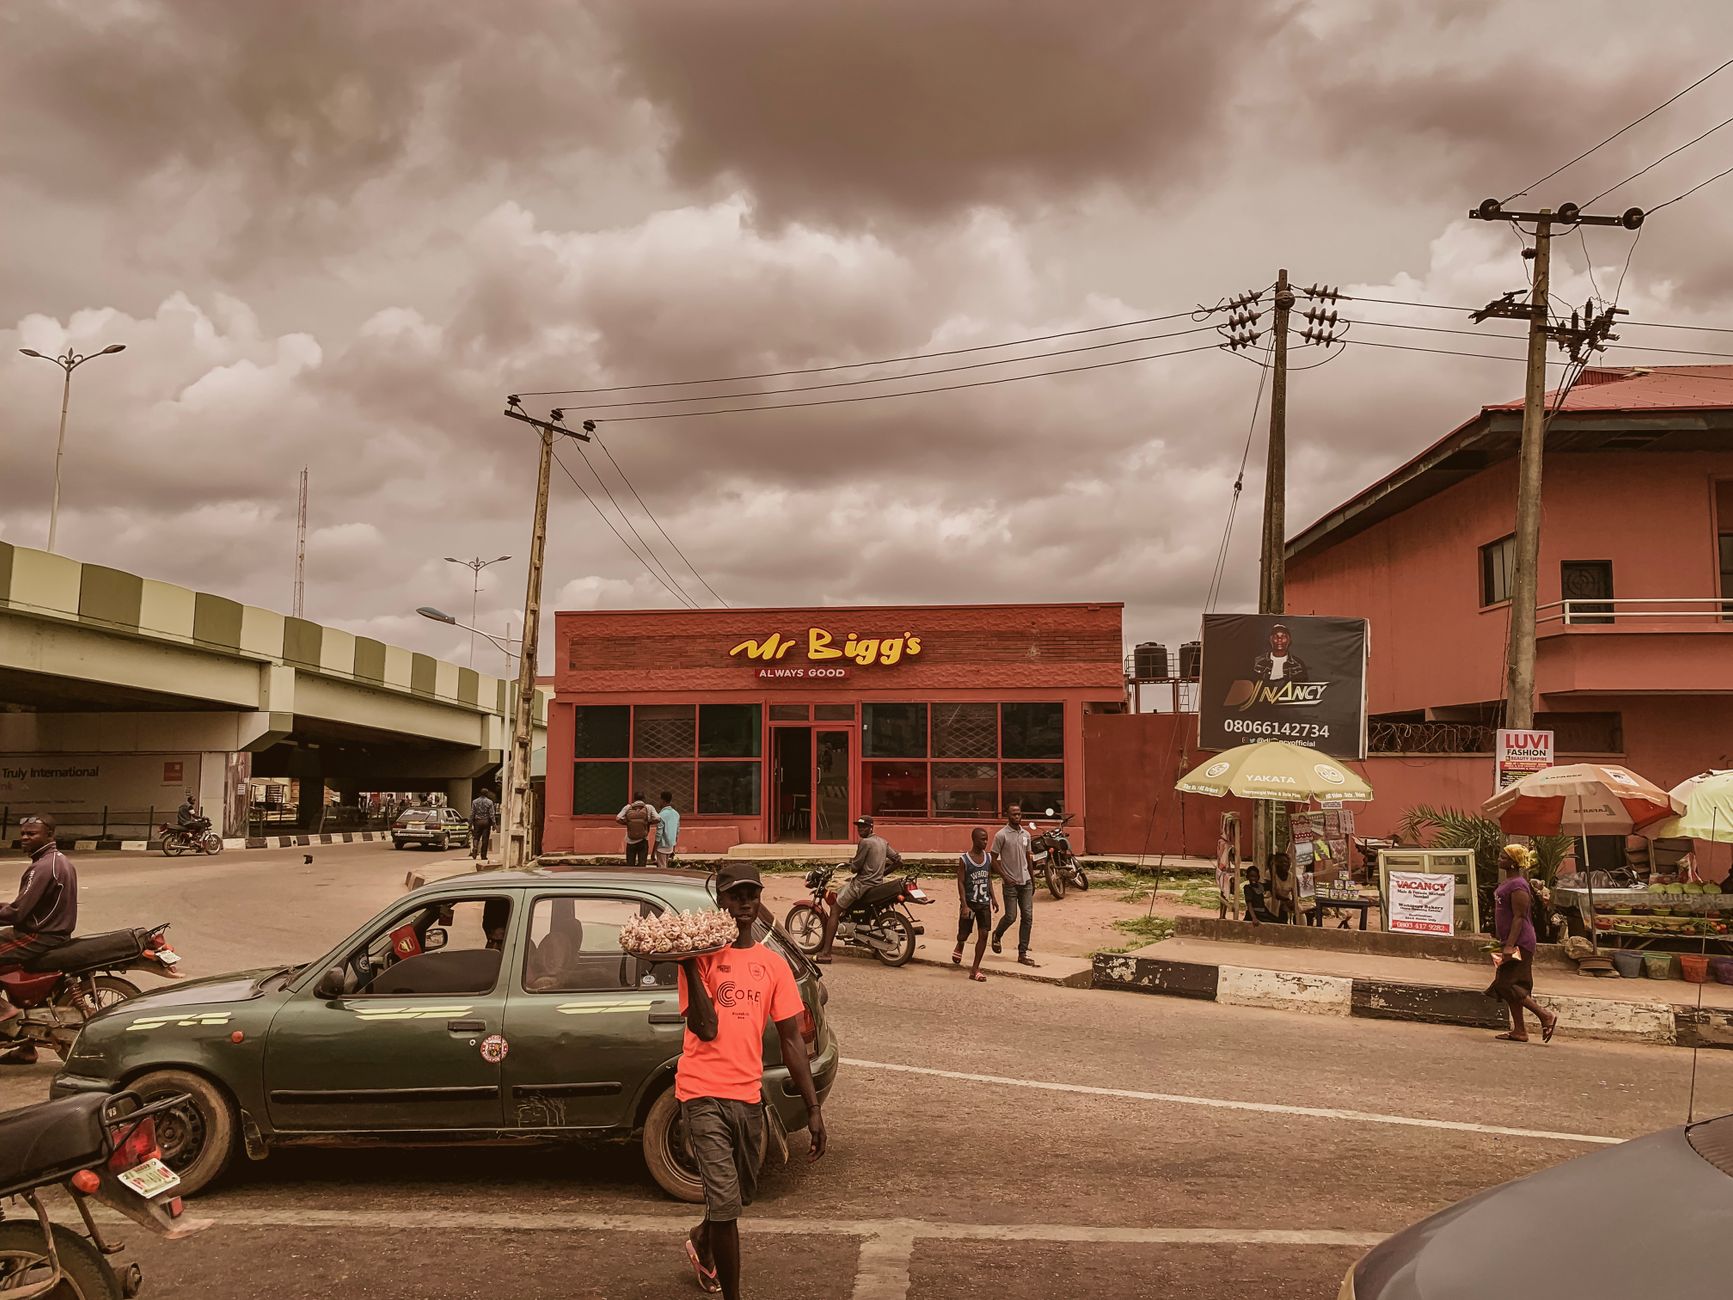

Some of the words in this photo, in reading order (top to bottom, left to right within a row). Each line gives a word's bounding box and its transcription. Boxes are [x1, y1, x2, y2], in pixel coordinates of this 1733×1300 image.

[729, 632, 796, 660] Mr
[807, 627, 922, 665] Bigg's
[759, 669, 804, 678] ALWAYS
[808, 669, 845, 677] GOOD
[1224, 719, 1330, 738] 08066142734
[1505, 734, 1549, 749] LUVI
[2, 767, 28, 780] Truly
[30, 766, 99, 778] International
[1245, 774, 1297, 784] YAKATA
[1396, 881, 1447, 891] VACANCY
[716, 981, 761, 1007] CORE
